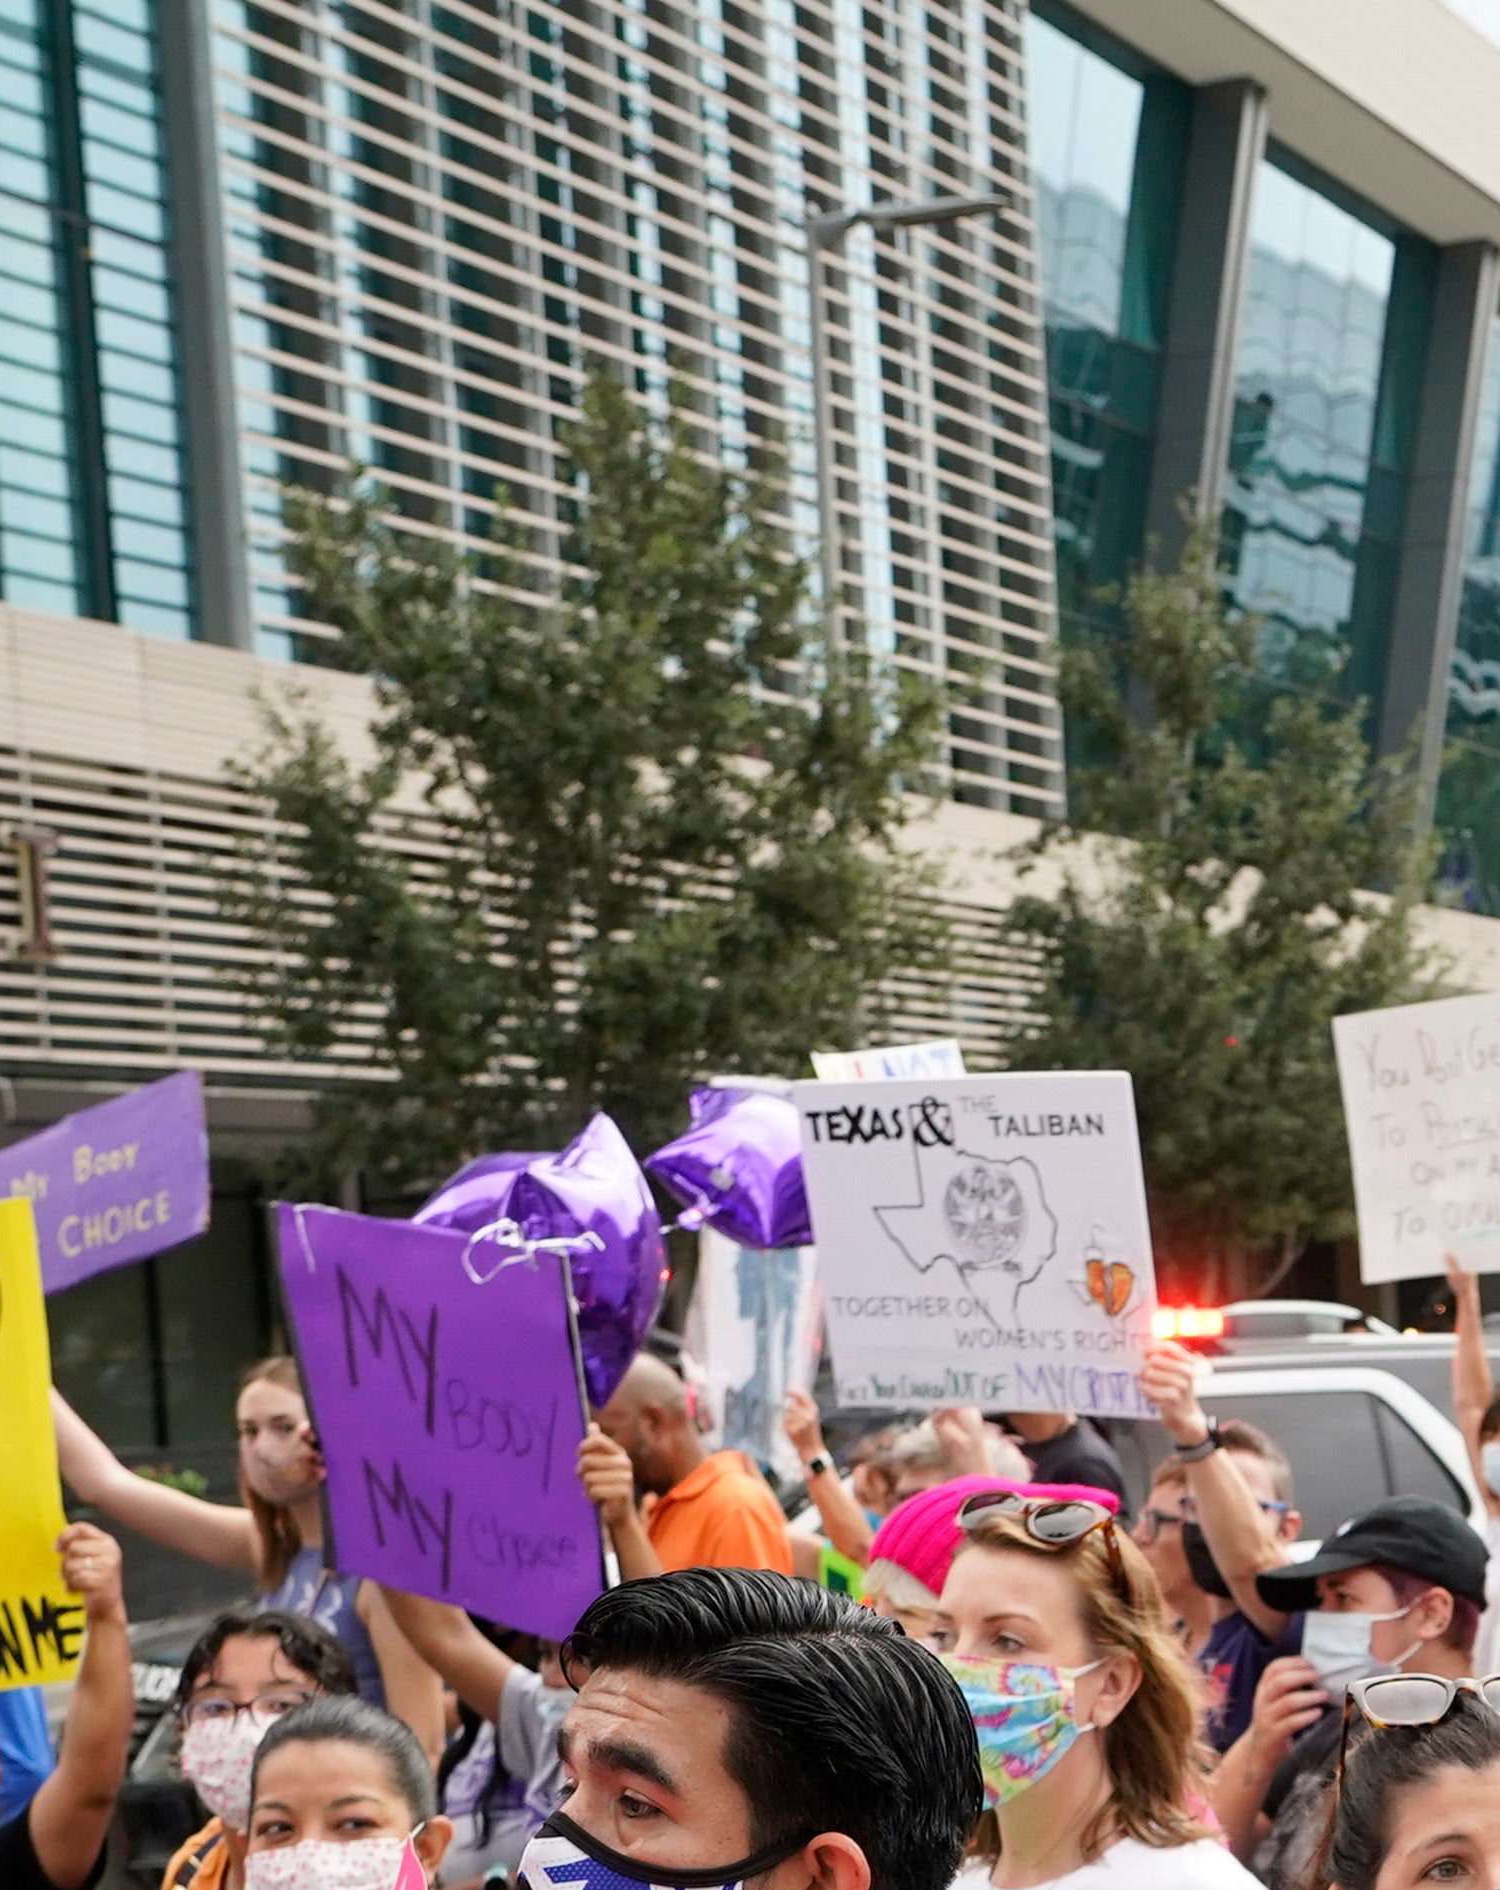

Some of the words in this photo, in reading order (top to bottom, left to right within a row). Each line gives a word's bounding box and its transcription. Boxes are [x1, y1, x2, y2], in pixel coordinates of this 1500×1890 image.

[804, 1103, 904, 1145] TEXAS
[911, 1095, 955, 1147] &
[988, 1112, 1106, 1137] TALIBAN
[57, 1189, 172, 1259] CHOICE
[831, 1295, 953, 1318] TOGETHER
[334, 1262, 439, 1436] MY
[362, 1456, 455, 1594] MY
[22, 1594, 87, 1668] ME
